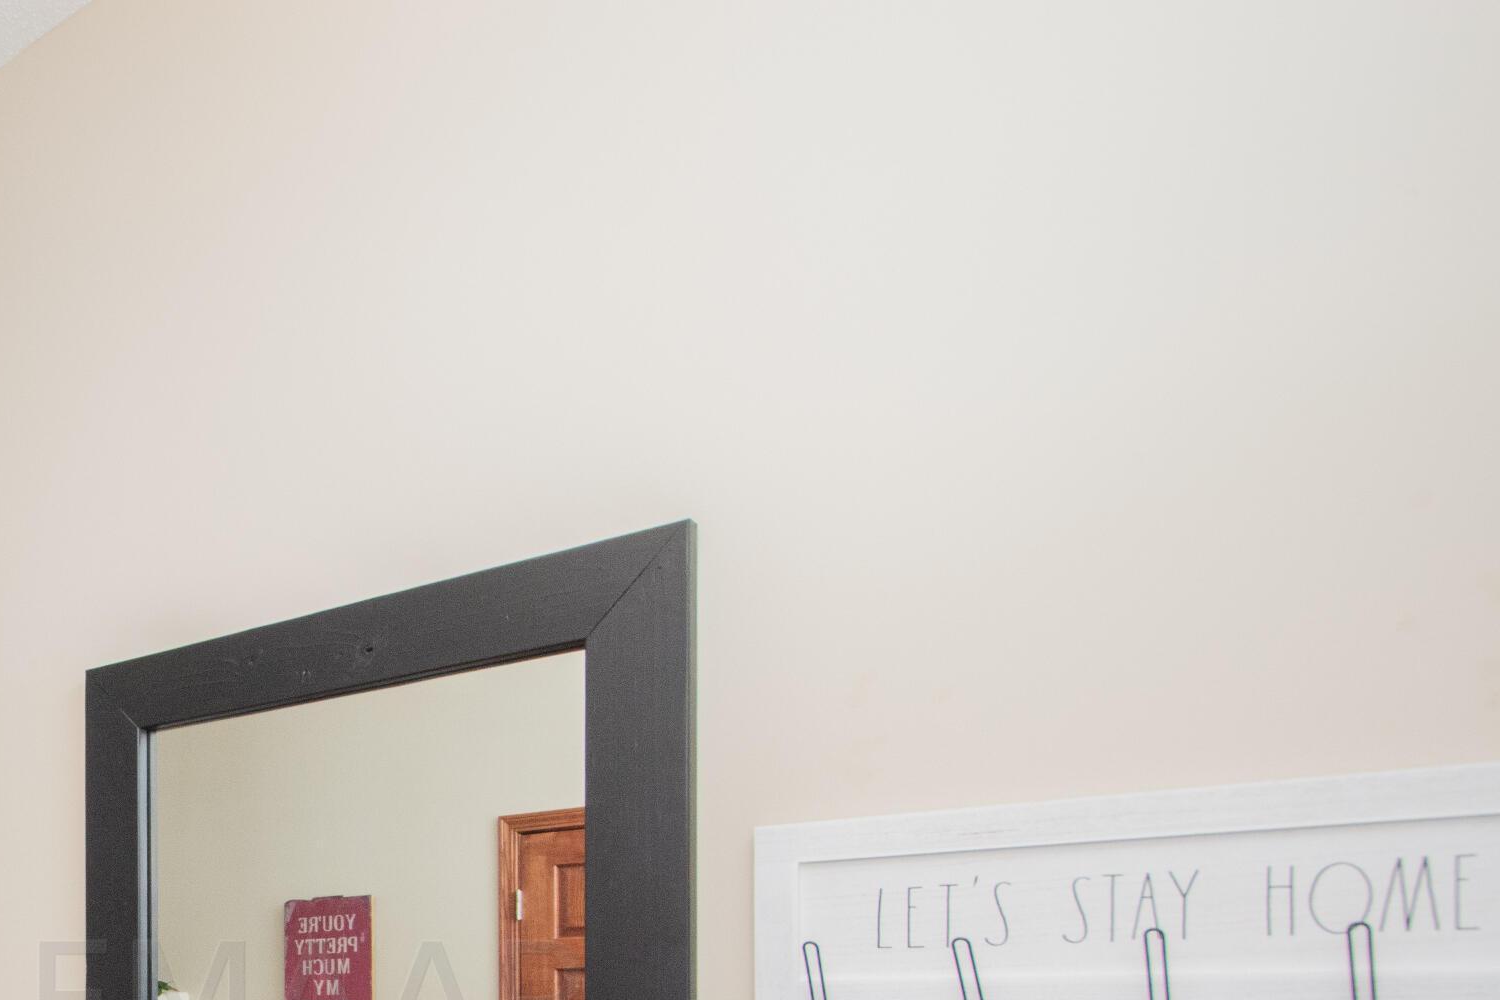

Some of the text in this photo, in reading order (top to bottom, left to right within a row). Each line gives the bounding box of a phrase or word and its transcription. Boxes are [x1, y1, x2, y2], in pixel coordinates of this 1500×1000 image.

[876, 853, 1481, 949] LET'S STAY HOME
